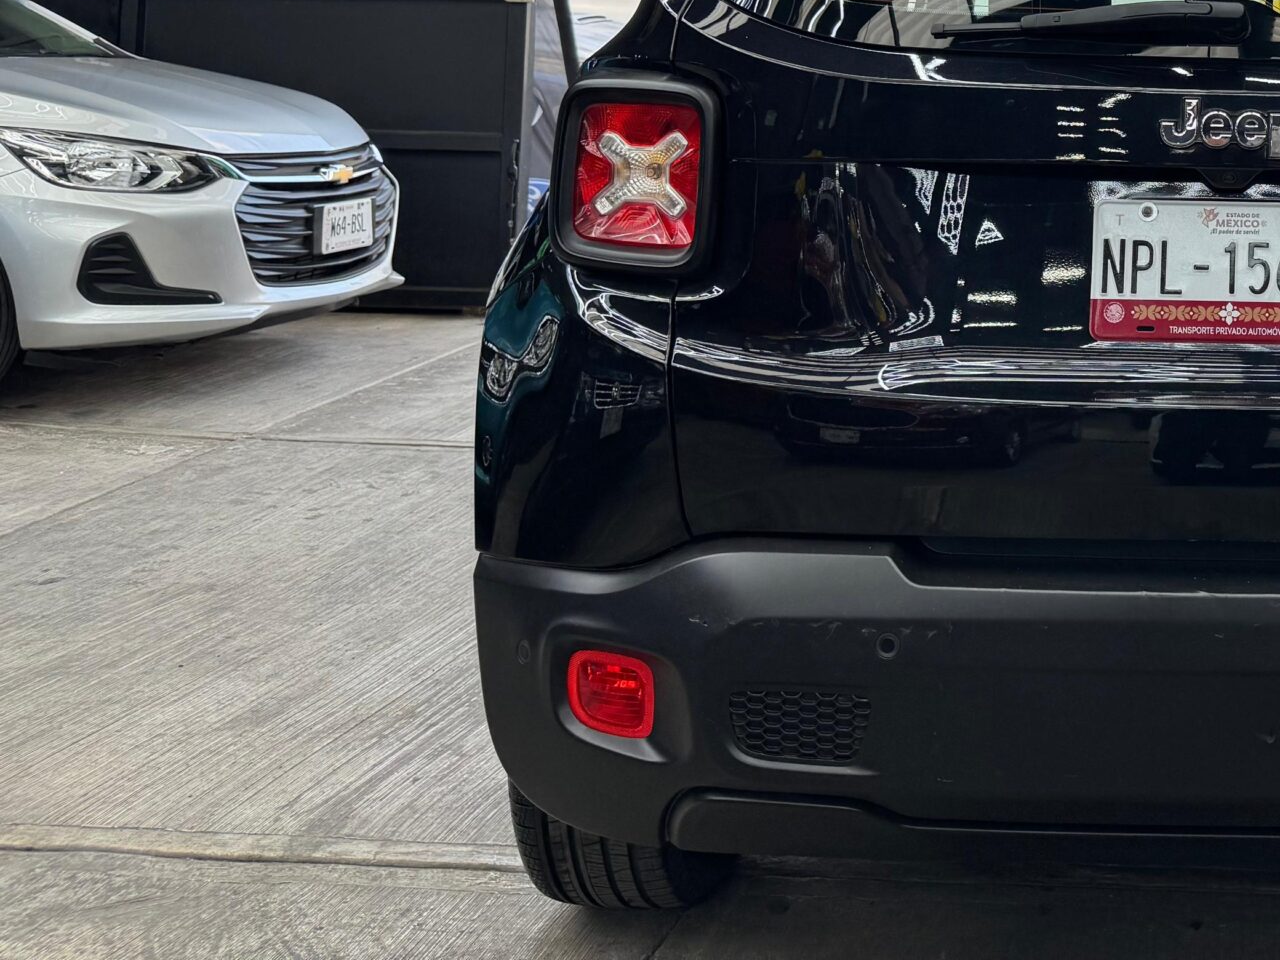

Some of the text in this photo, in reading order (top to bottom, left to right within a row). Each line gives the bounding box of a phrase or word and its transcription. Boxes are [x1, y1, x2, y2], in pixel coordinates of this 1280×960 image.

[1218, 228, 1234, 236] poder
[1169, 325, 1214, 335] TRANSPORTE
[1215, 327, 1247, 335] PRIVADO
